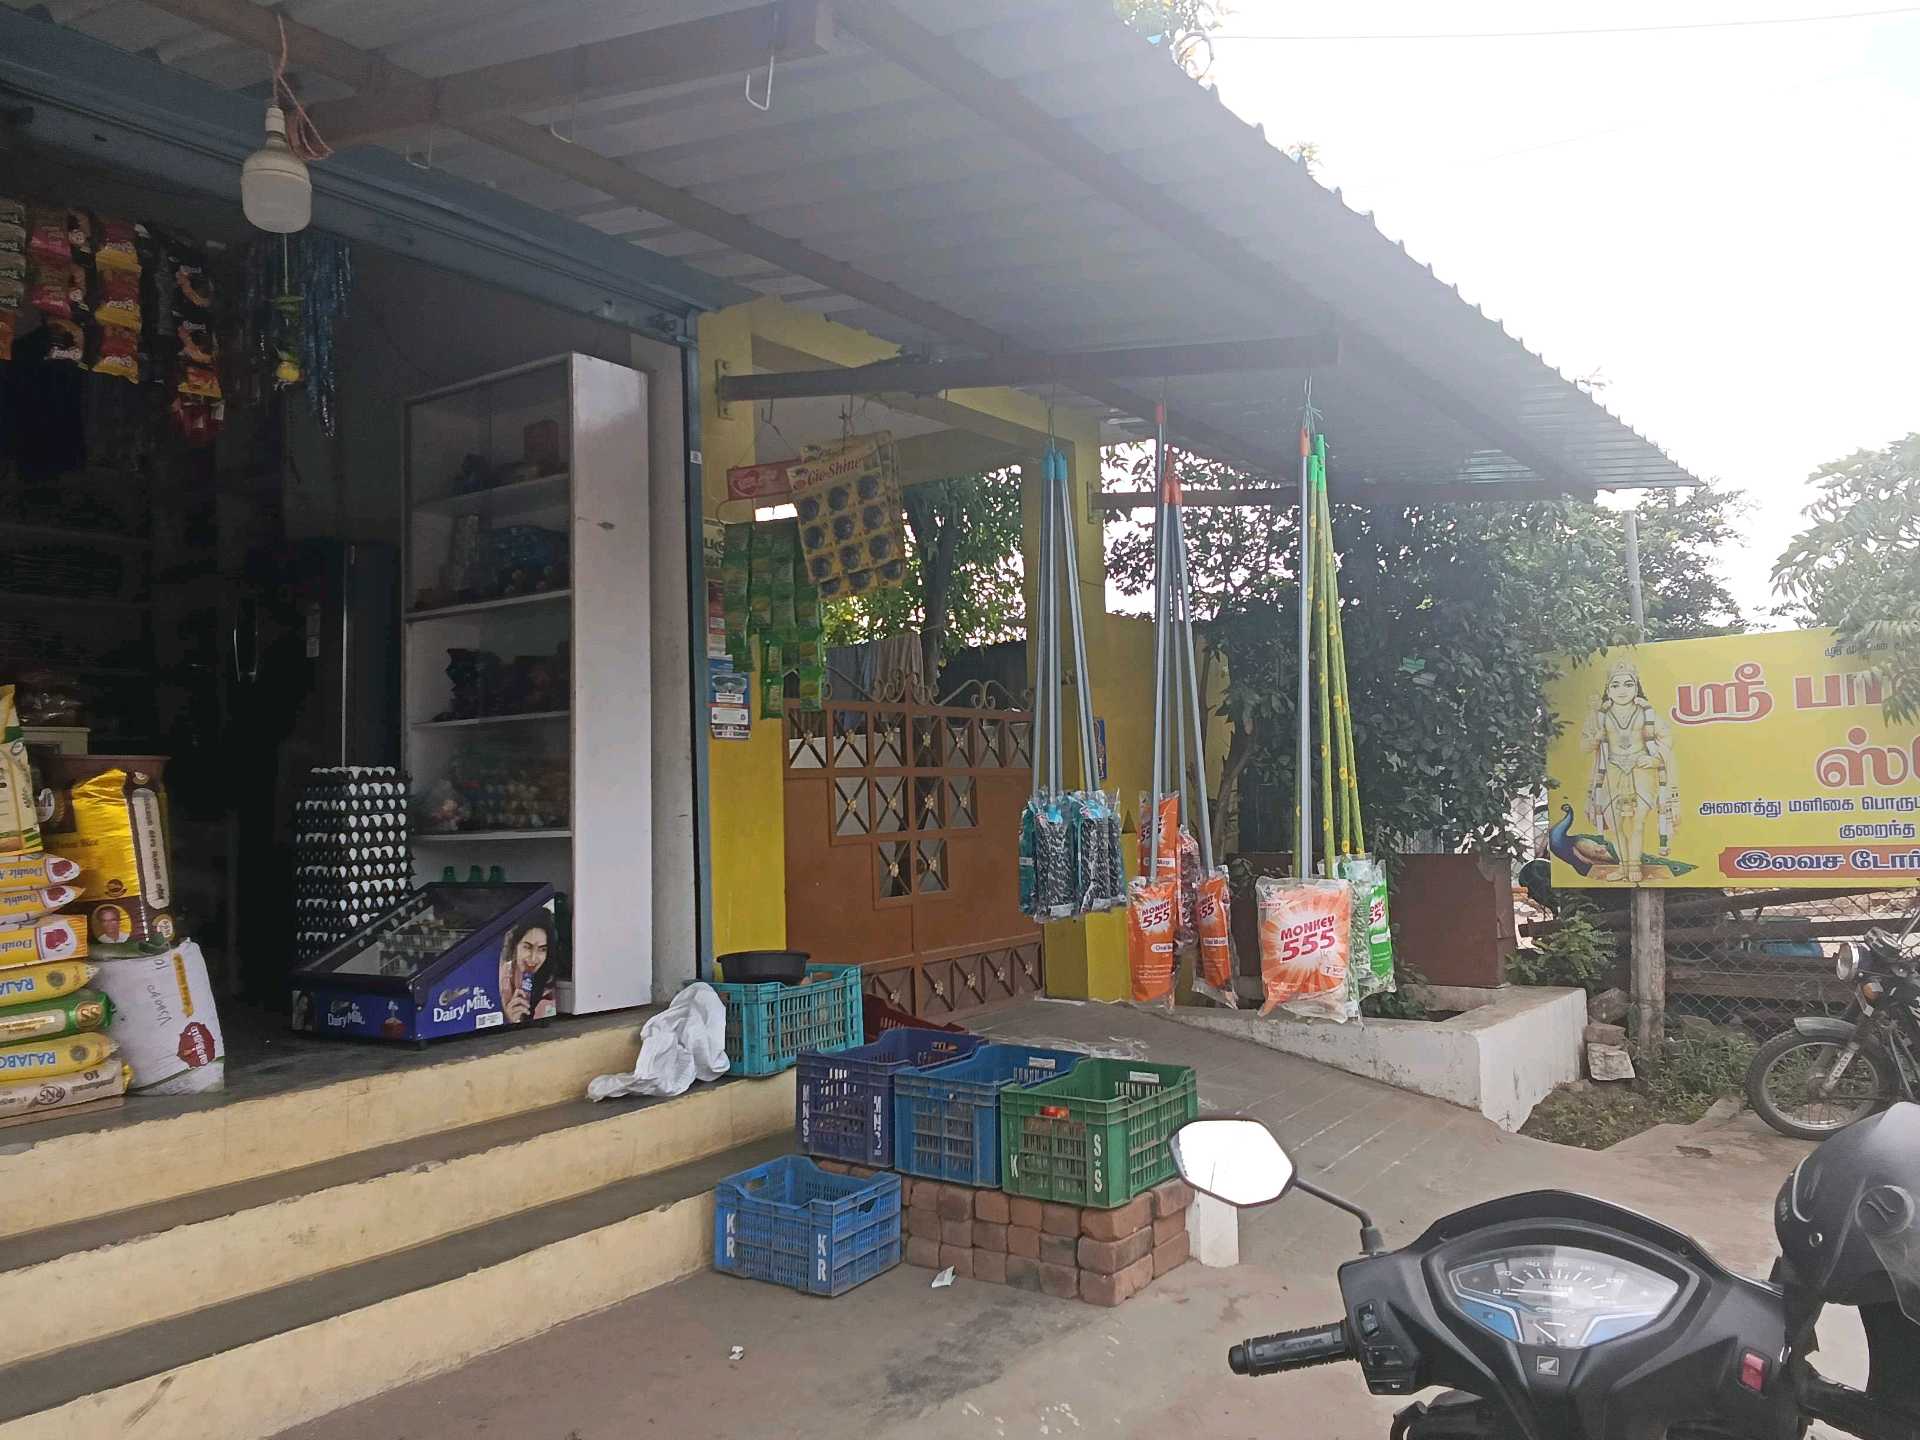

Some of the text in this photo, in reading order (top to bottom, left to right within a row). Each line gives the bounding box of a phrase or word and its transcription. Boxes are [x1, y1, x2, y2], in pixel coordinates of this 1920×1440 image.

[1815, 726, 1920, 789] ஸ்
[1699, 797, 1782, 818] அனைத்து
[1789, 797, 1855, 813] மளிகை
[1839, 819, 1916, 839] குறைந்த
[1735, 849, 1845, 870] இலவச
[1142, 908, 1171, 929] 555
[1280, 915, 1335, 941] MONKEY
[1281, 927, 1336, 962] 555
[0, 977, 34, 995] RAJA
[433, 1005, 466, 1023] Dairy
[467, 997, 495, 1012] Milk
